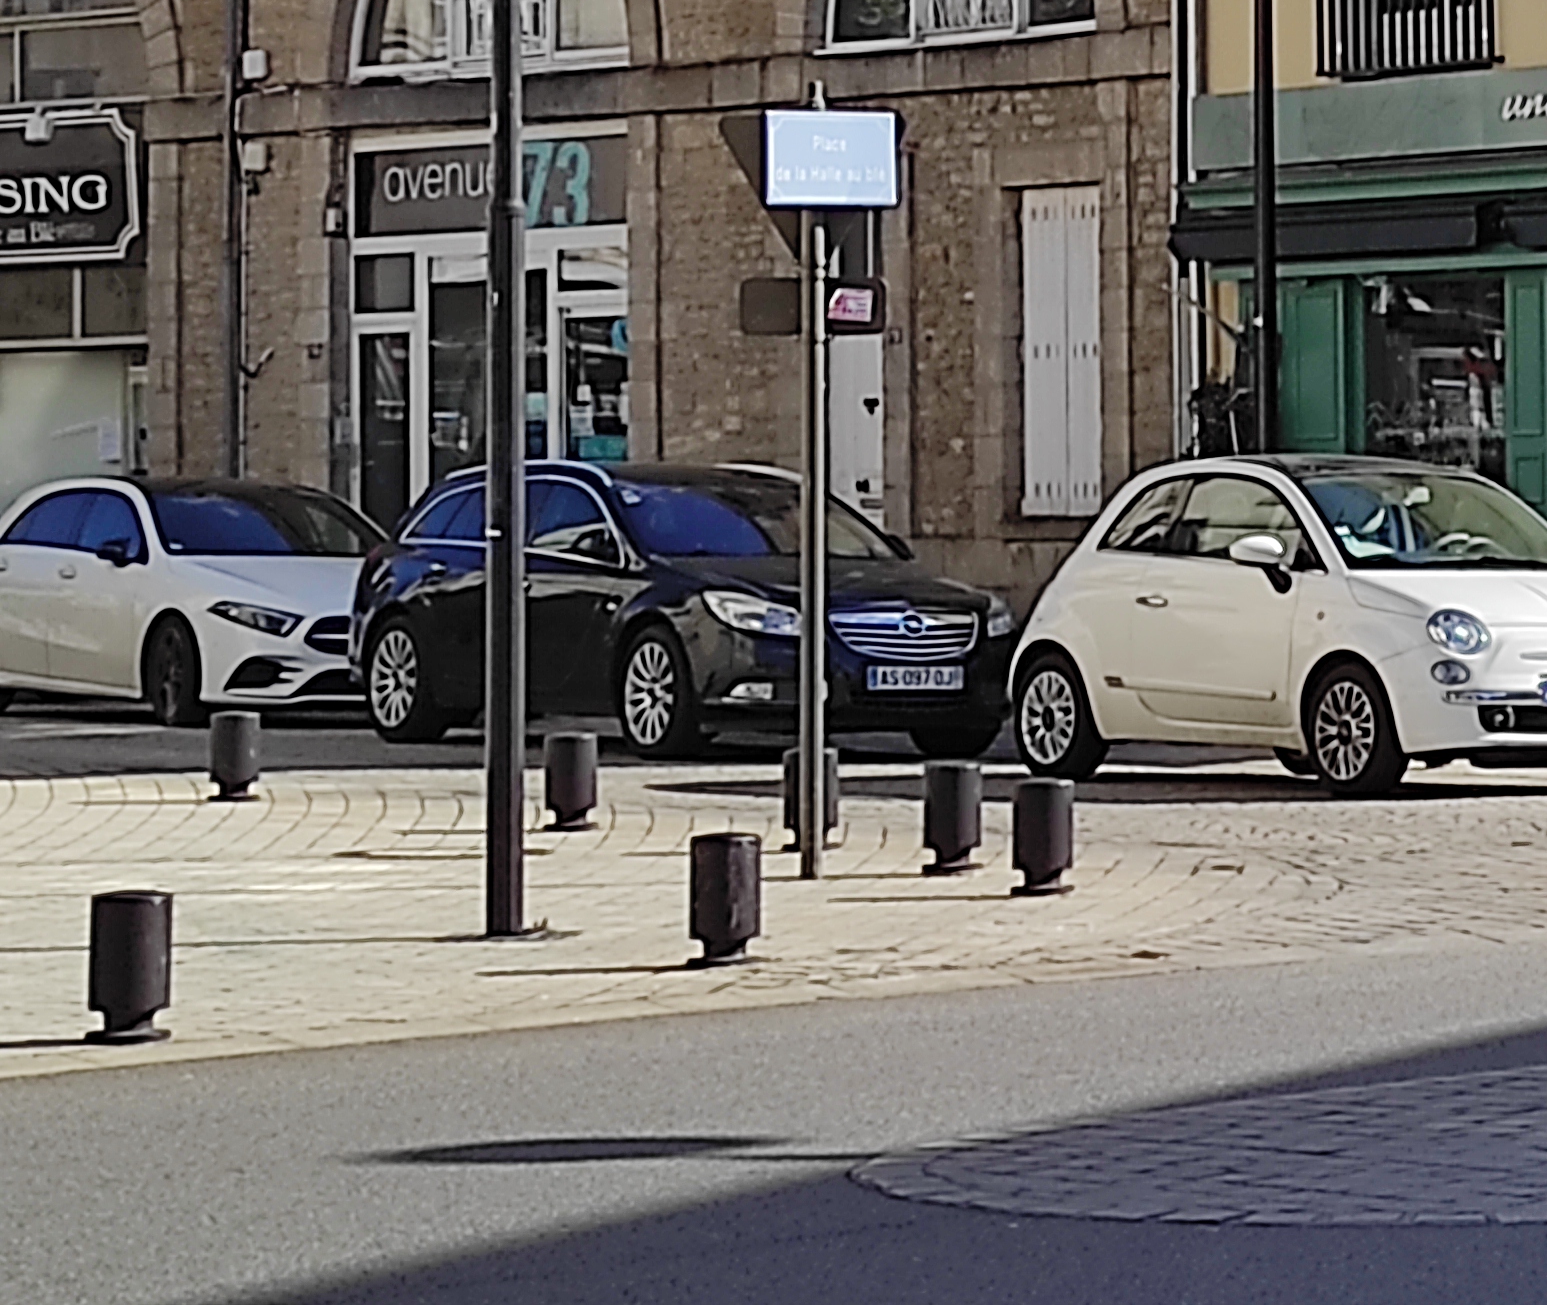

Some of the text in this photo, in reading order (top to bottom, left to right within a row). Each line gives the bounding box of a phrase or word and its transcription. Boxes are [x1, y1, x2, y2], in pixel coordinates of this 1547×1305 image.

[812, 134, 847, 153] Place
[383, 140, 590, 228] avenu 73
